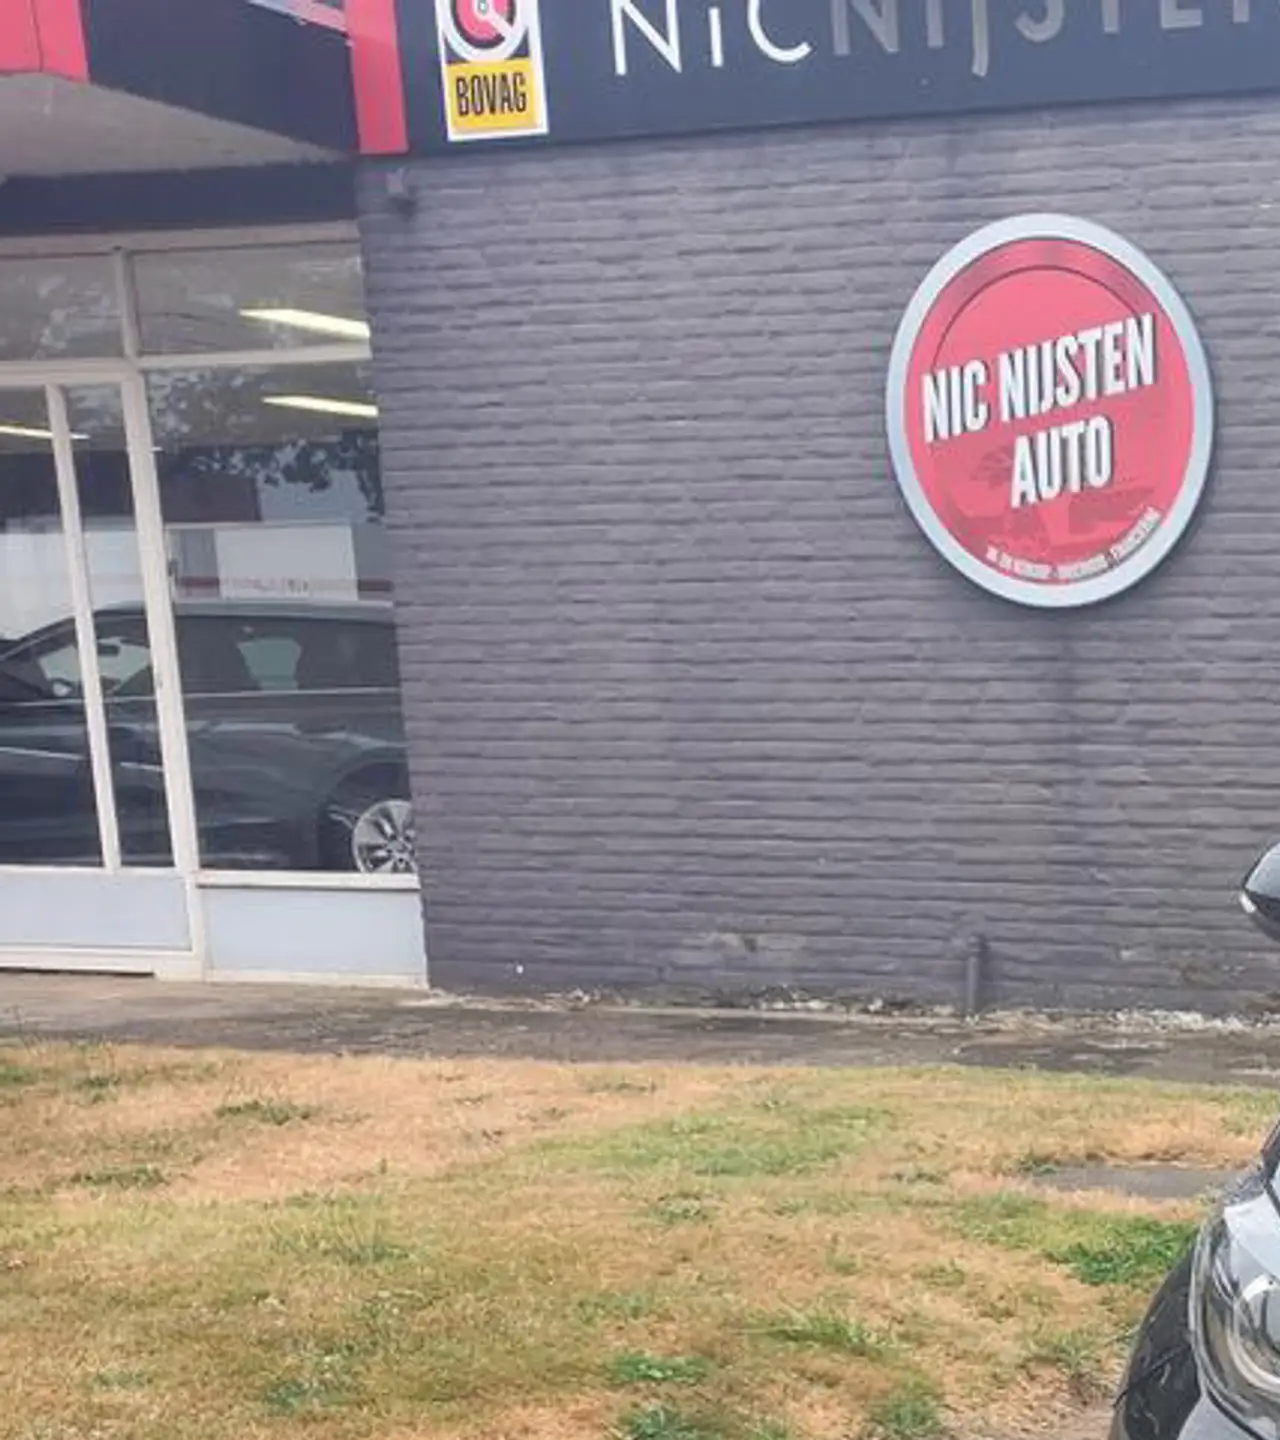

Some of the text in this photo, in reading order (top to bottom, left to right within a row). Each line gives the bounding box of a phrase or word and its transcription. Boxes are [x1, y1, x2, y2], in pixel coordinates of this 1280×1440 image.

[455, 71, 528, 118] BOVAG
[921, 311, 1157, 444] NIC NIJSTEN
[1009, 414, 1114, 509] AUTO
